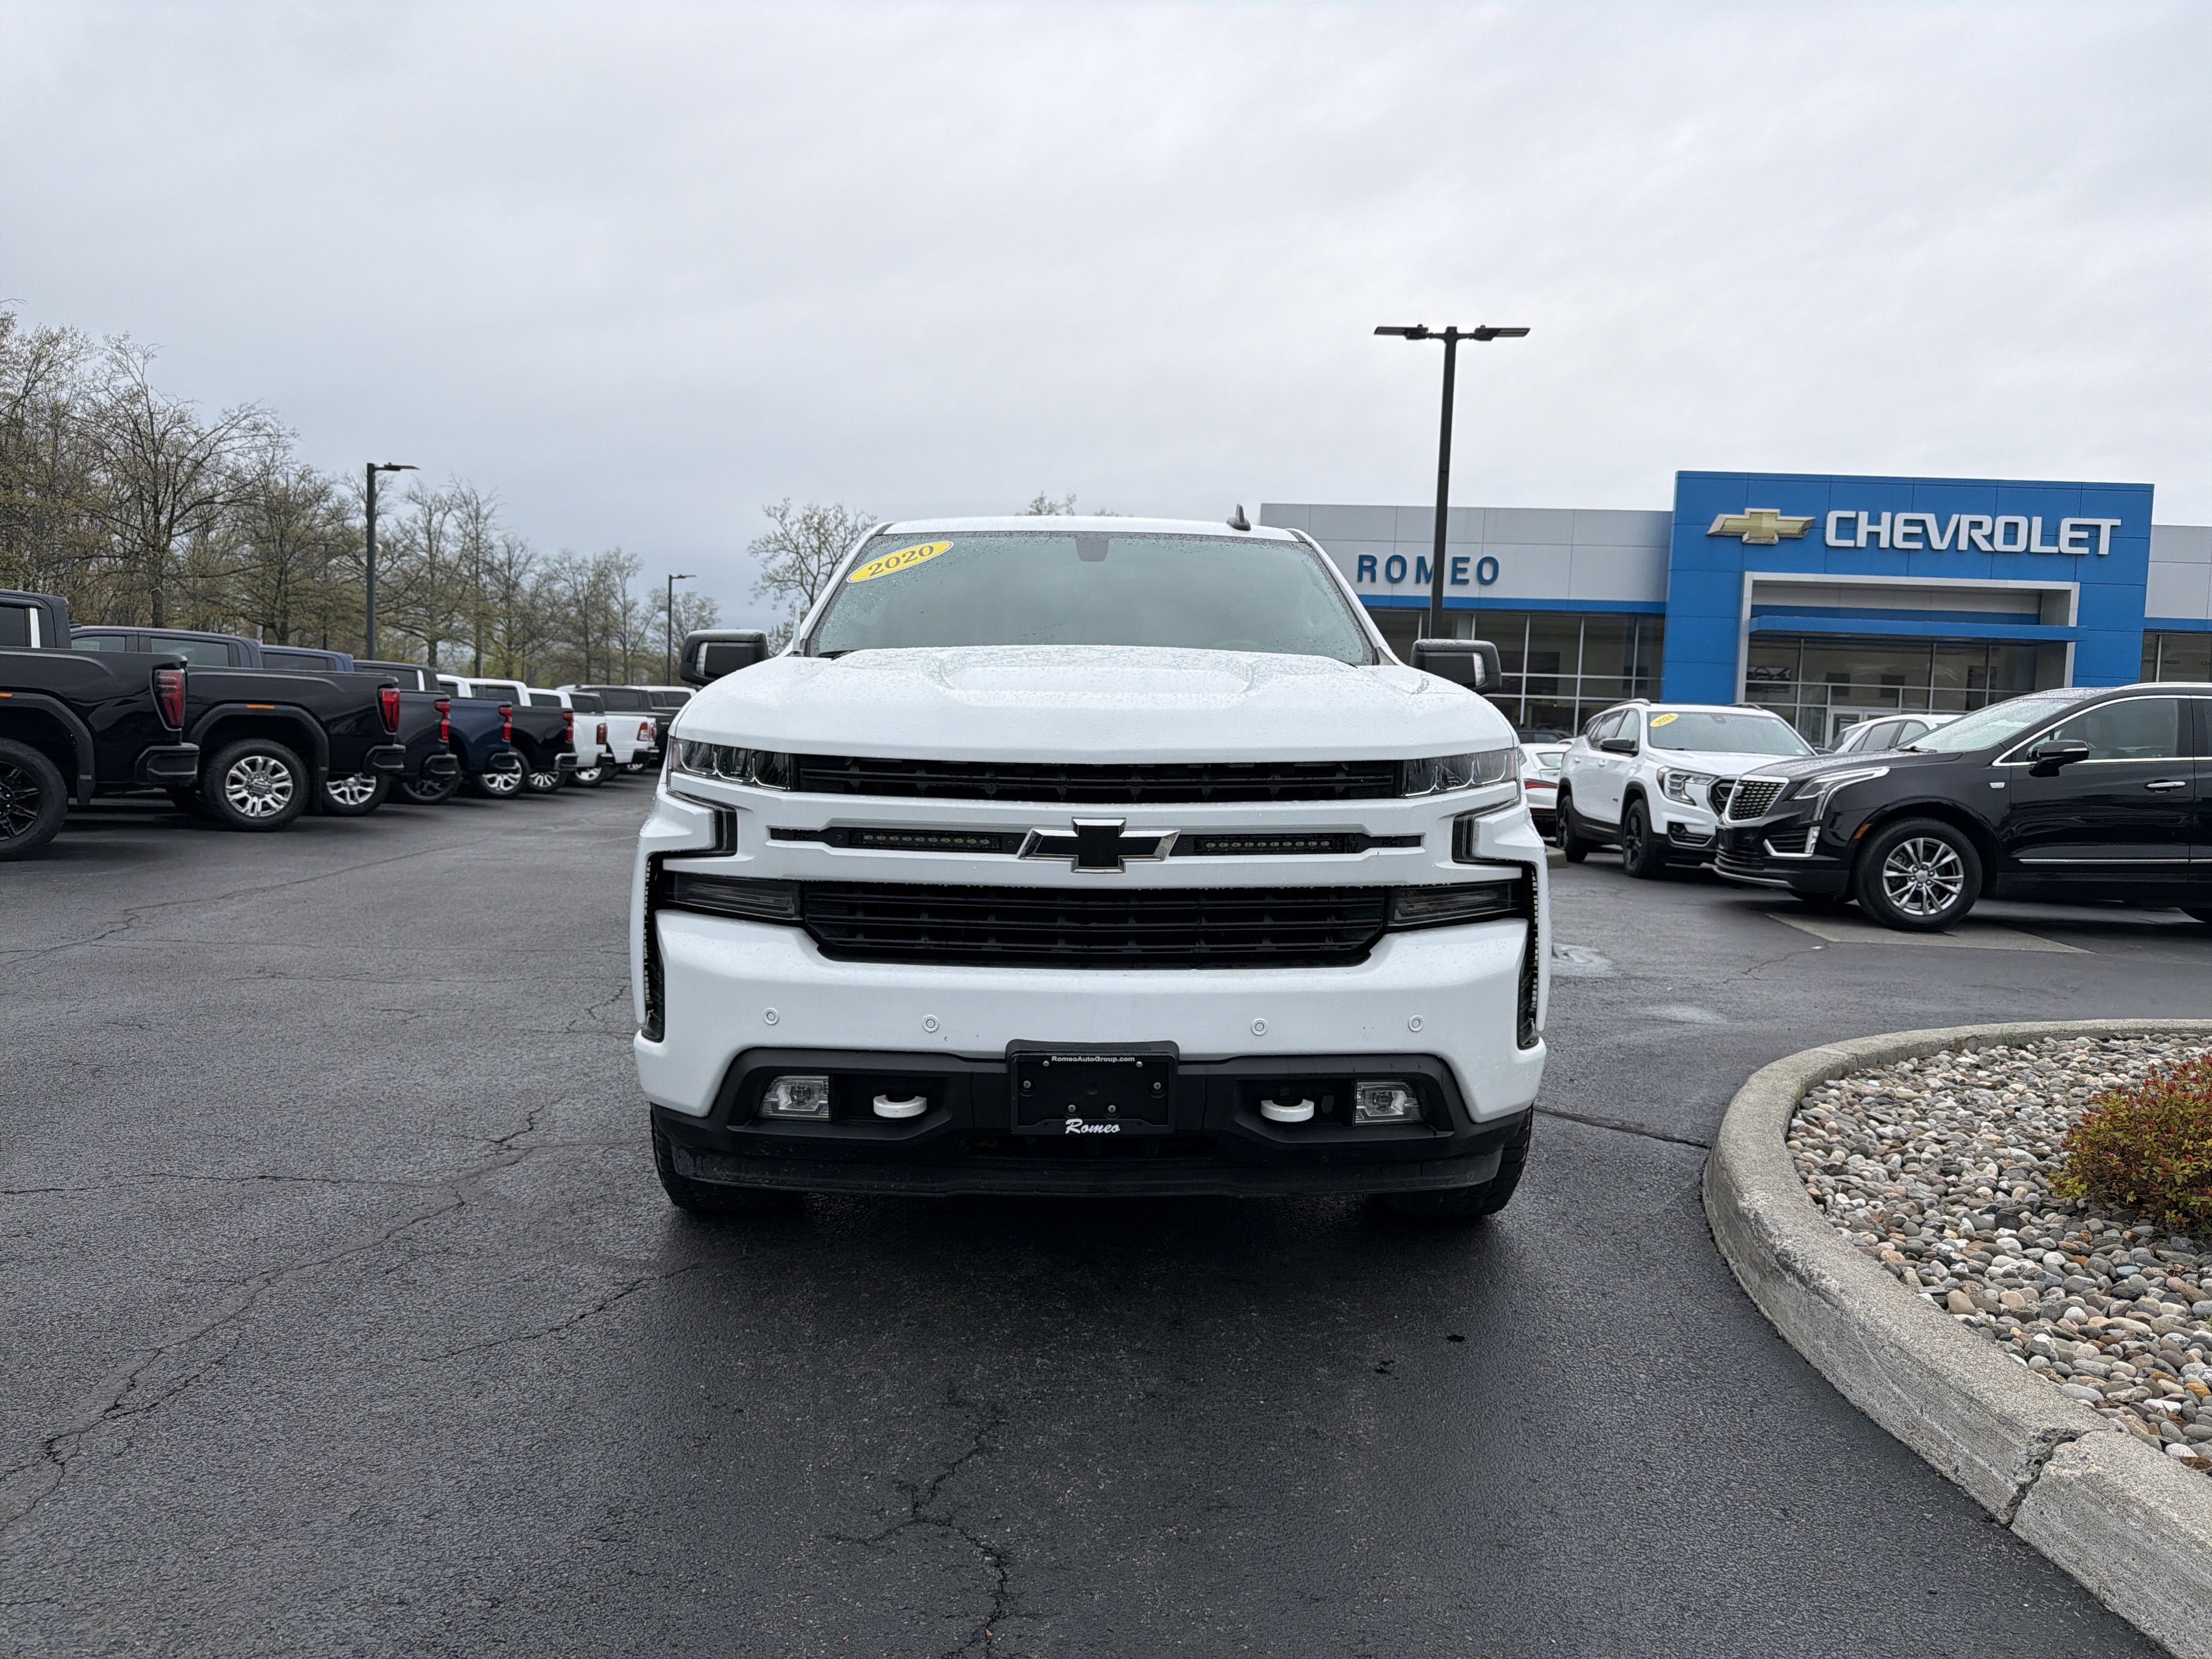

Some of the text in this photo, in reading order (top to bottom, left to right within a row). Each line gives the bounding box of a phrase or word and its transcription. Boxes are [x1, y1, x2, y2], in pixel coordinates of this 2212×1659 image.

[1825, 510, 2122, 555] CHEVROLET
[868, 545, 934, 577] 2020
[1357, 554, 1499, 585] ROMEO
[1065, 1118, 1121, 1135] Romeo
